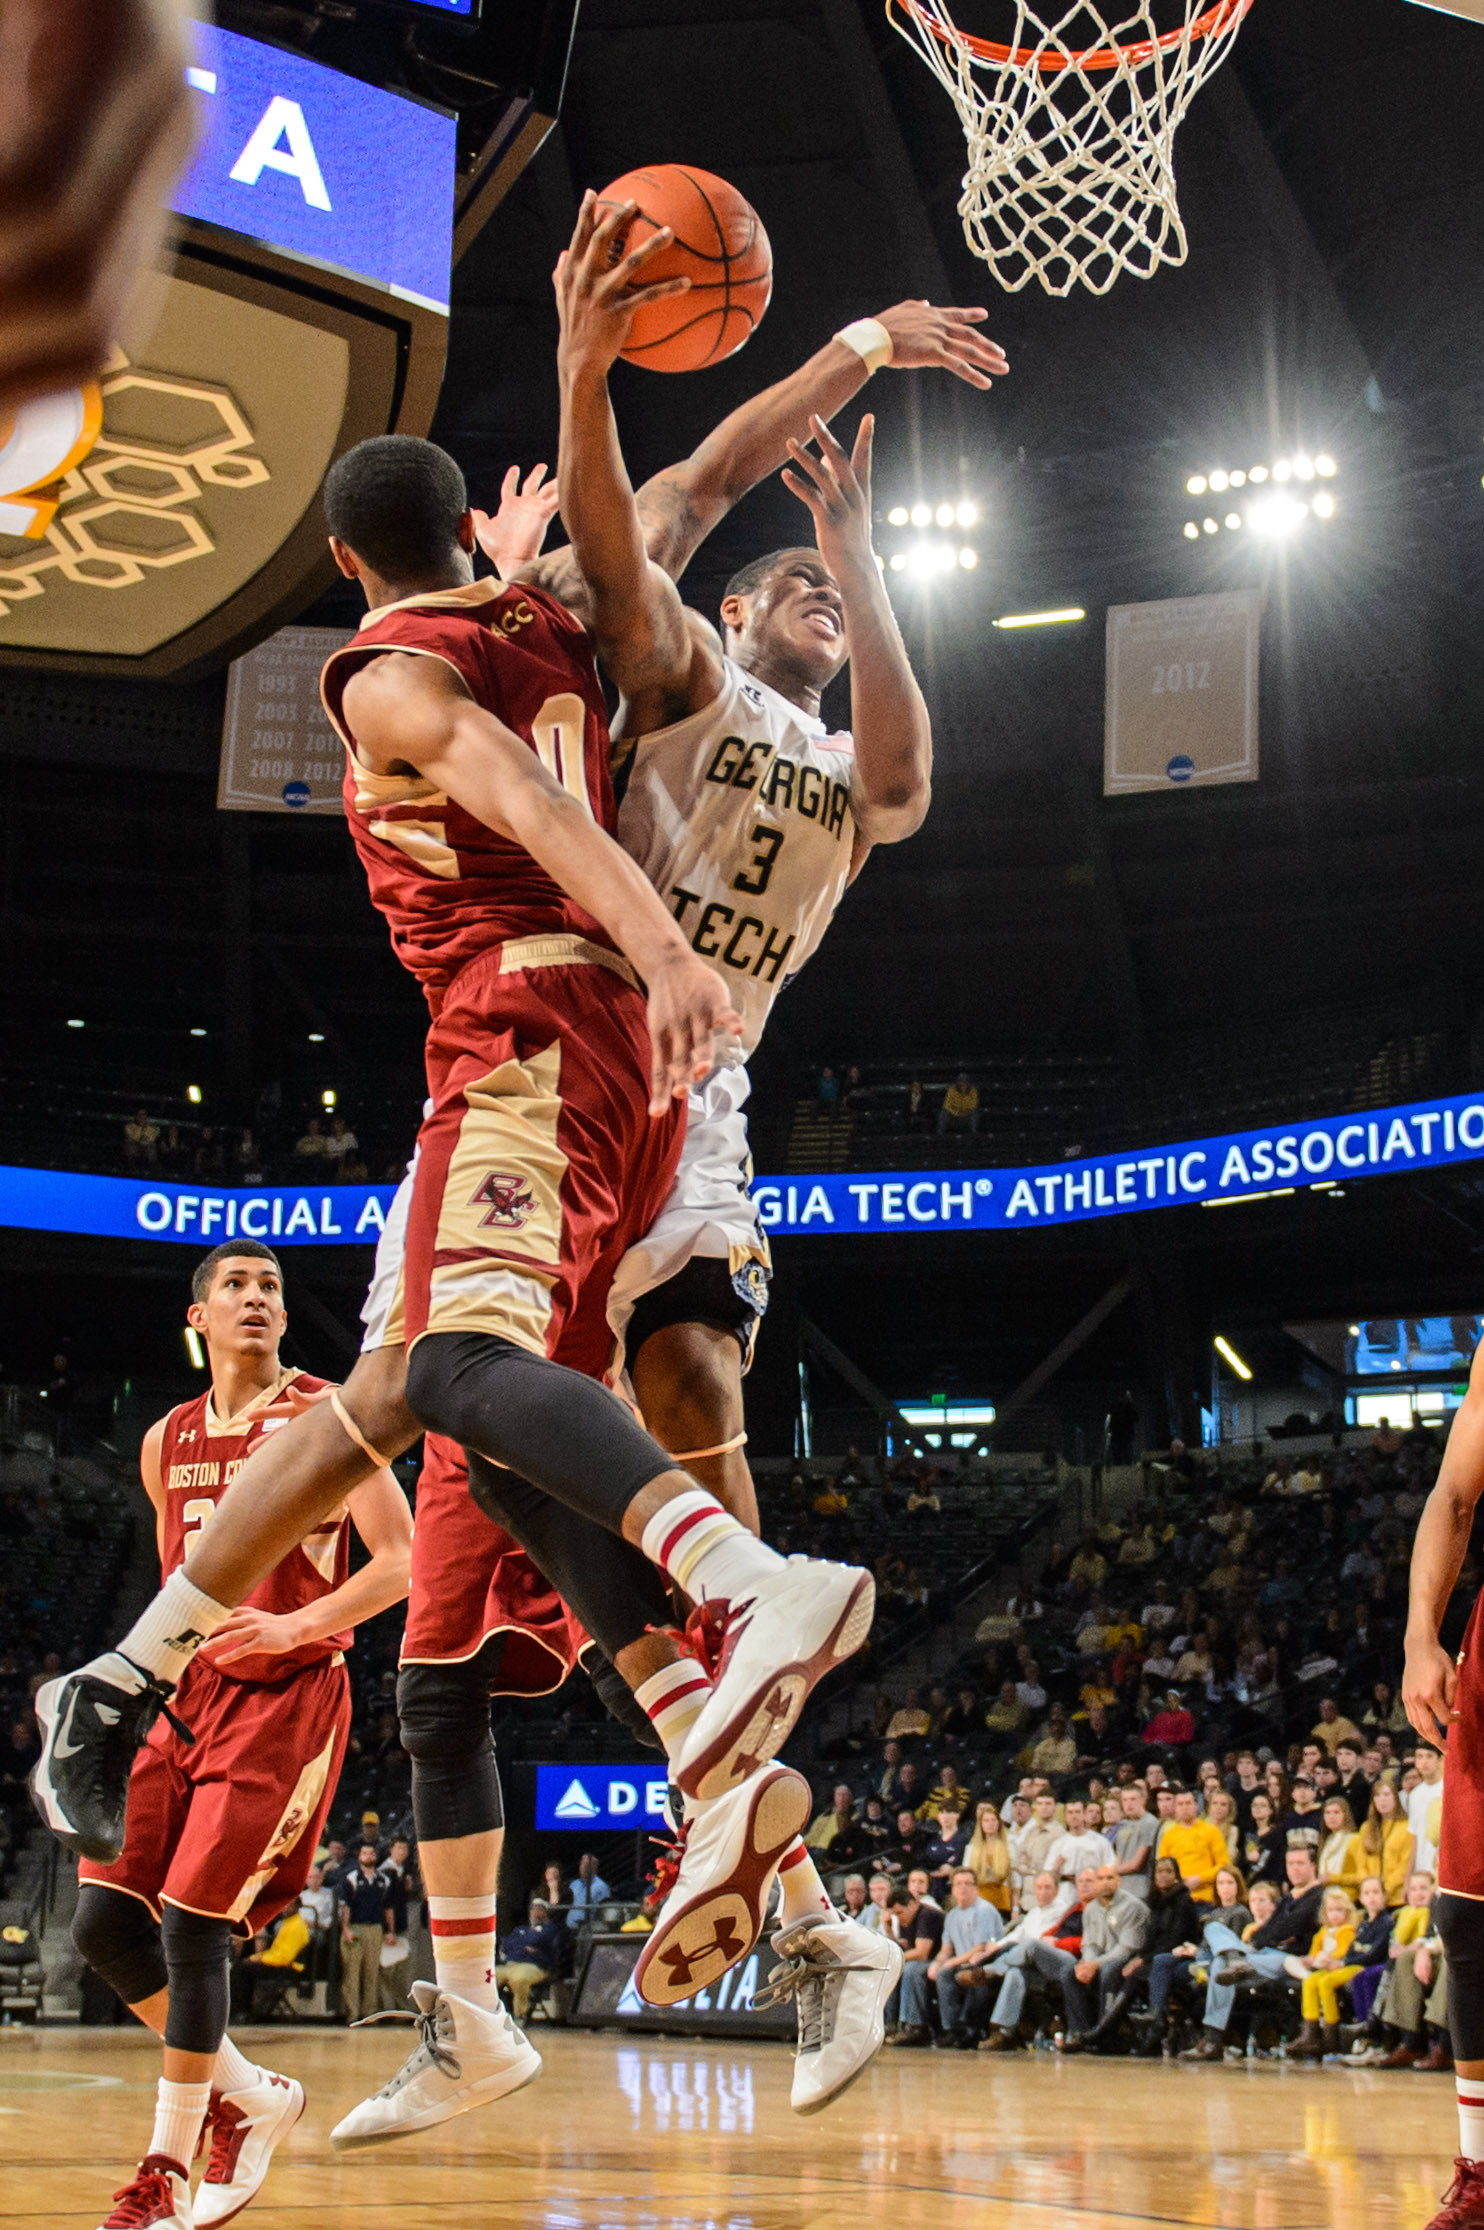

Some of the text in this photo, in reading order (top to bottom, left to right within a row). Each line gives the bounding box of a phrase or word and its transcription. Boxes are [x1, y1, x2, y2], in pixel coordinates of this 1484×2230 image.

[491, 602, 533, 638] ACC
[1151, 660, 1213, 695] 2012
[251, 729, 295, 750] 2007
[303, 761, 342, 782] 2012
[734, 825, 785, 896] 3
[669, 887, 796, 983] TECH
[136, 1191, 343, 1238] OFFICIAL
[354, 1195, 387, 1234] A
[1005, 1151, 1208, 1219] ATHLETIC
[1219, 1104, 1484, 1188] ASSOCIATIO
[168, 1457, 247, 1490] BOSTON CO
